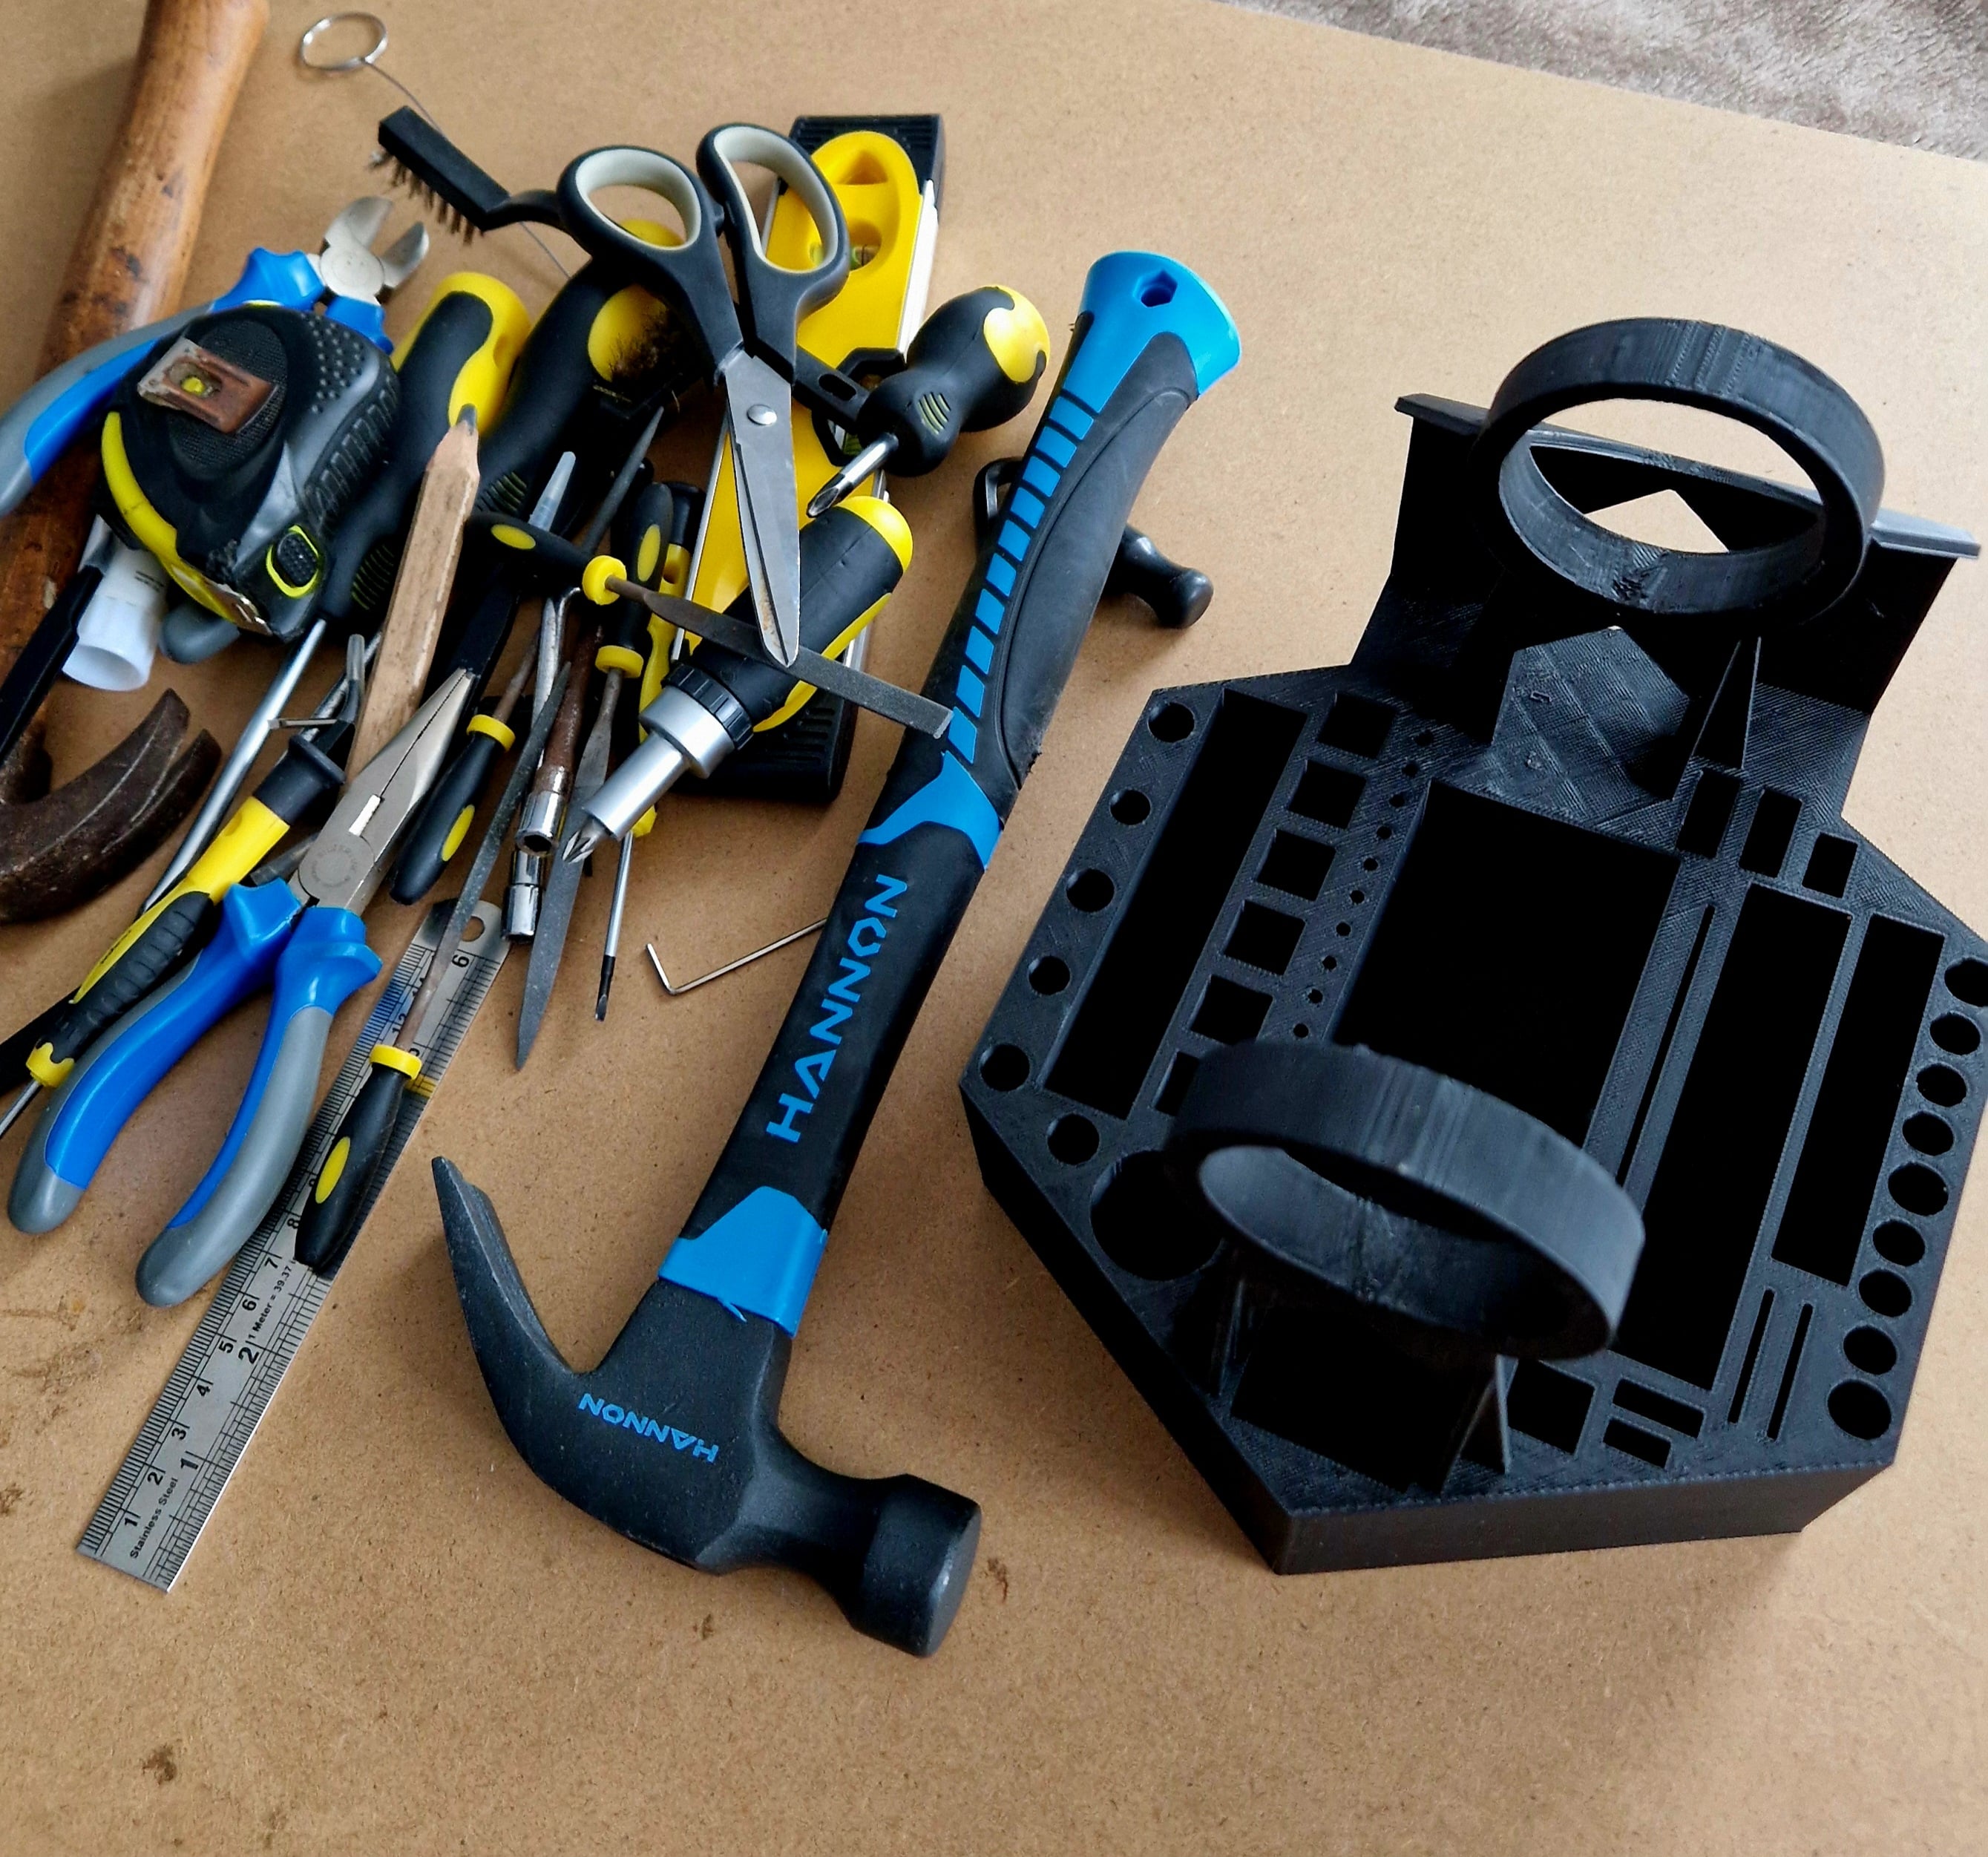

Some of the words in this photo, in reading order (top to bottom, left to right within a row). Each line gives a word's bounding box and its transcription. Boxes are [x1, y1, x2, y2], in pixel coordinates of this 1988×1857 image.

[766, 874, 908, 1143] HANNON
[180, 1458, 199, 1470] 1
[237, 1346, 260, 1364] 2
[452, 954, 470, 968] 6
[252, 1302, 272, 1332] Meter
[274, 1265, 292, 1292] 39.37
[125, 1517, 138, 1527] 1
[147, 1471, 163, 1485] 2
[171, 1427, 187, 1441] 3
[197, 1384, 211, 1397] 4
[218, 1340, 234, 1354] 5
[242, 1299, 257, 1311] 6
[264, 1257, 278, 1268] 7
[578, 1392, 719, 1464] HANNON
[130, 1508, 162, 1559] Stainless
[158, 1477, 178, 1506] Steel
